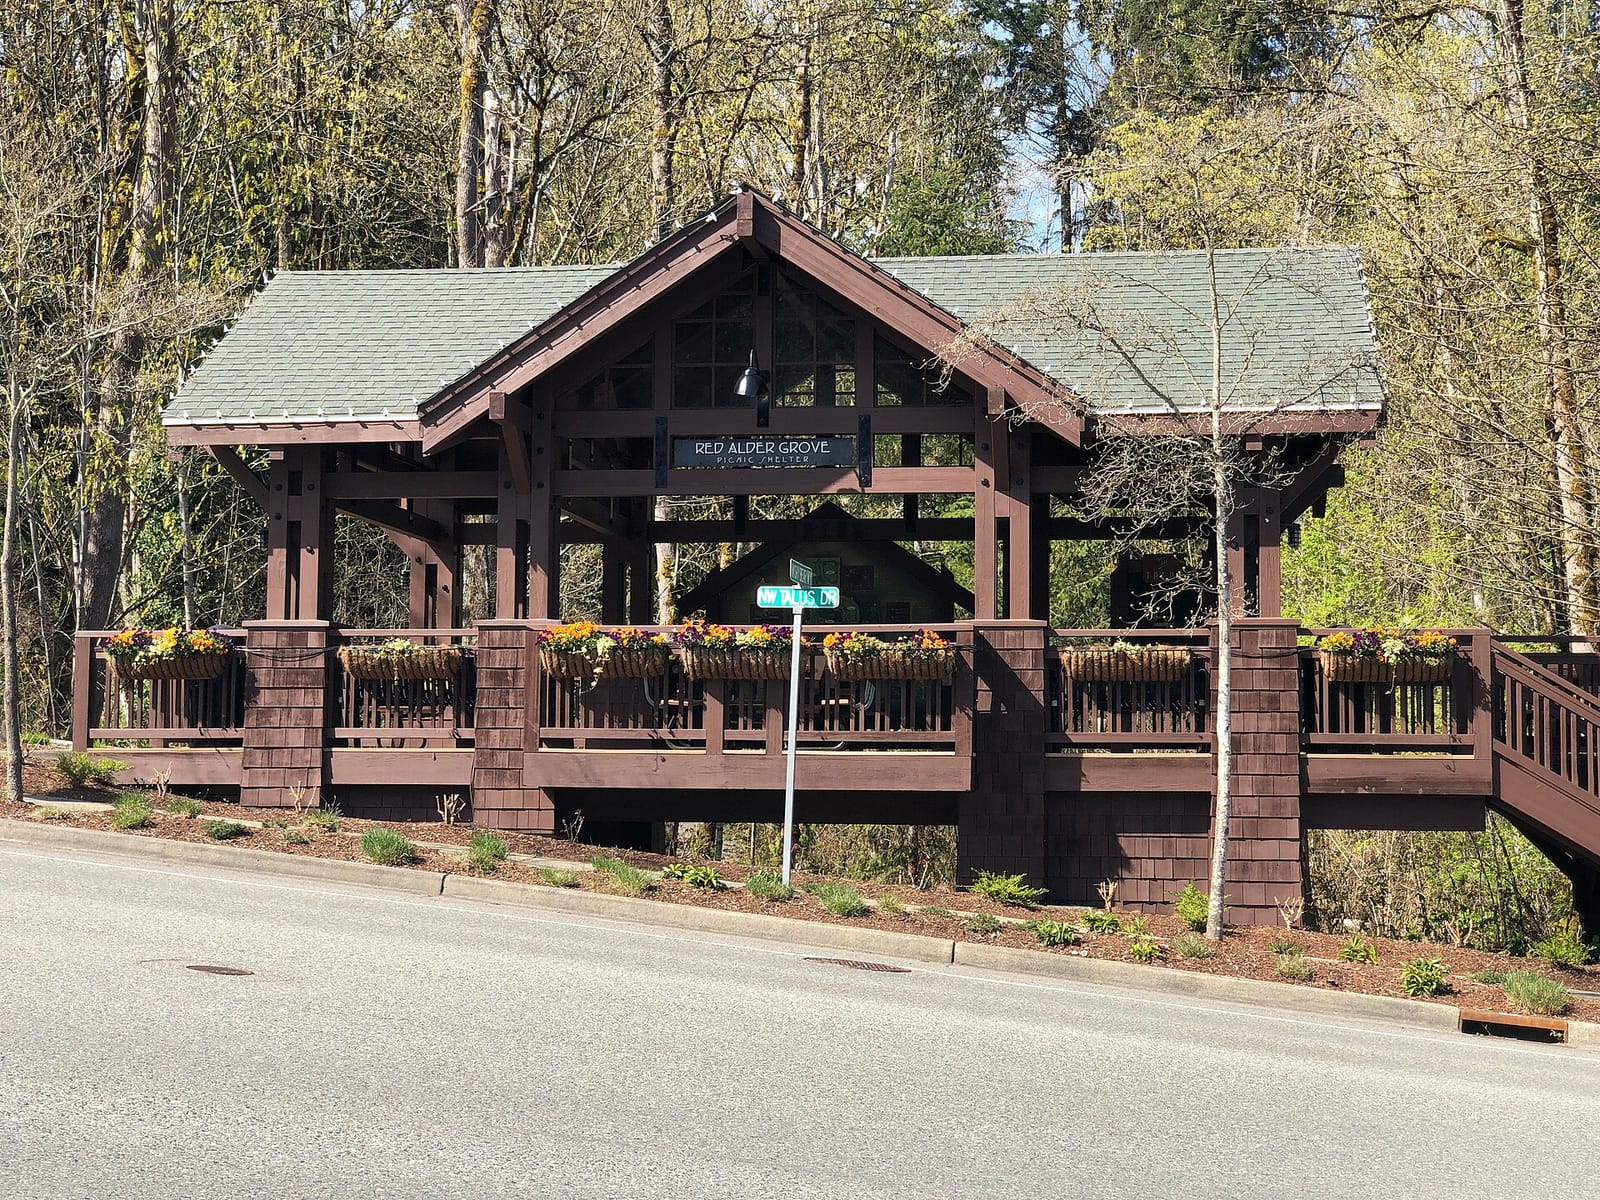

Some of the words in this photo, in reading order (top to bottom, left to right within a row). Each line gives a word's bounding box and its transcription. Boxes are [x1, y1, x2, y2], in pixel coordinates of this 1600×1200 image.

[695, 442, 723, 454] RED
[728, 441, 775, 454] ALDER
[779, 440, 831, 454] GROVE
[716, 456, 754, 464] PICNIC
[760, 455, 809, 464] SHELTER
[760, 588, 776, 605] NW
[780, 588, 815, 606] TALUS
[820, 590, 837, 606] DR
